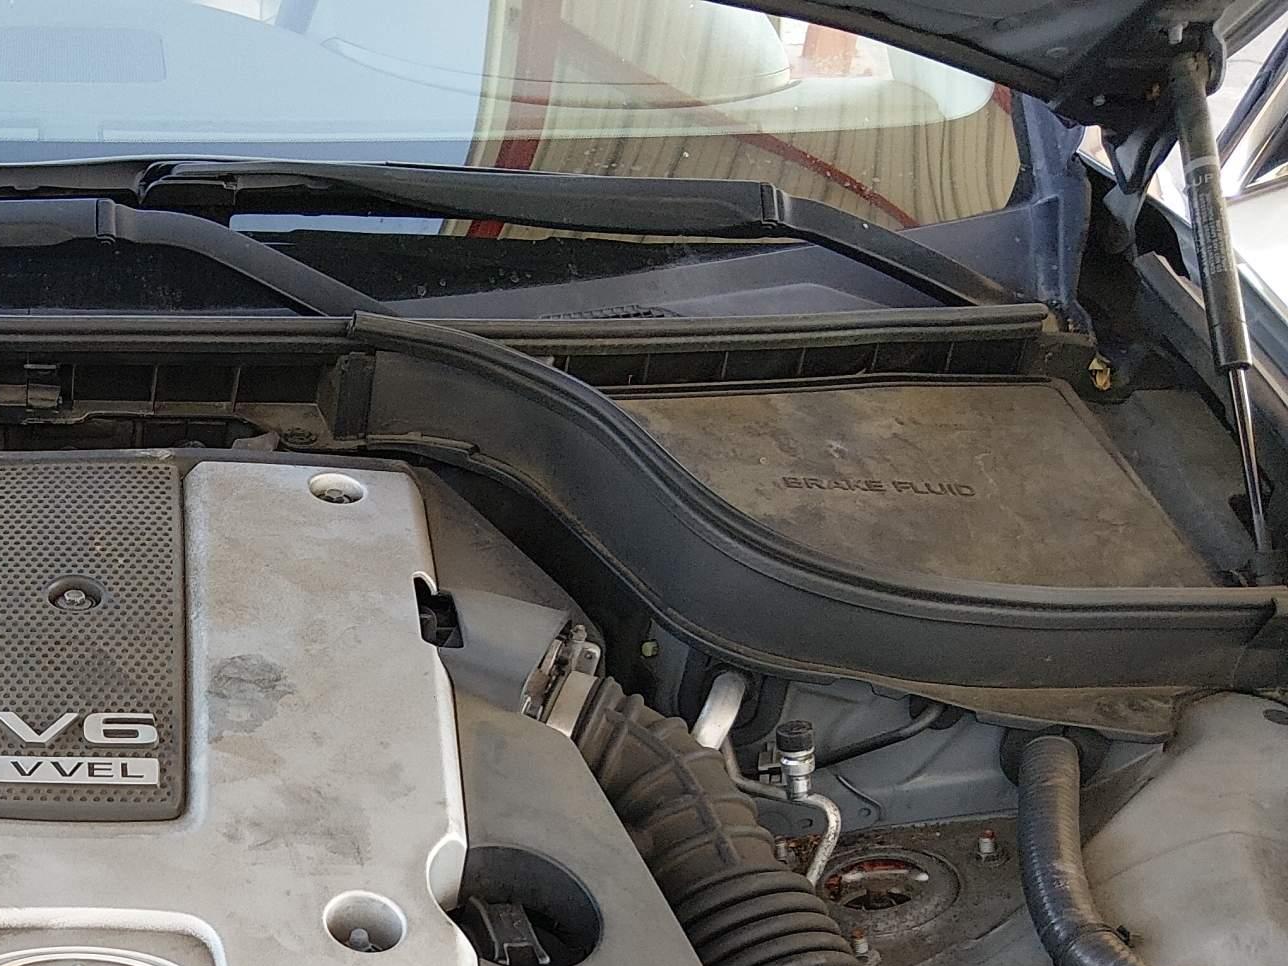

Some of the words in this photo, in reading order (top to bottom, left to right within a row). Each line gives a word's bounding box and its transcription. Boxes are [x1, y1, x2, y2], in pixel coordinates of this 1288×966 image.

[1192, 173, 1214, 186] UP
[781, 476, 886, 493] BRAKE
[892, 480, 977, 497] FLUID
[10, 760, 144, 778] VVEL
